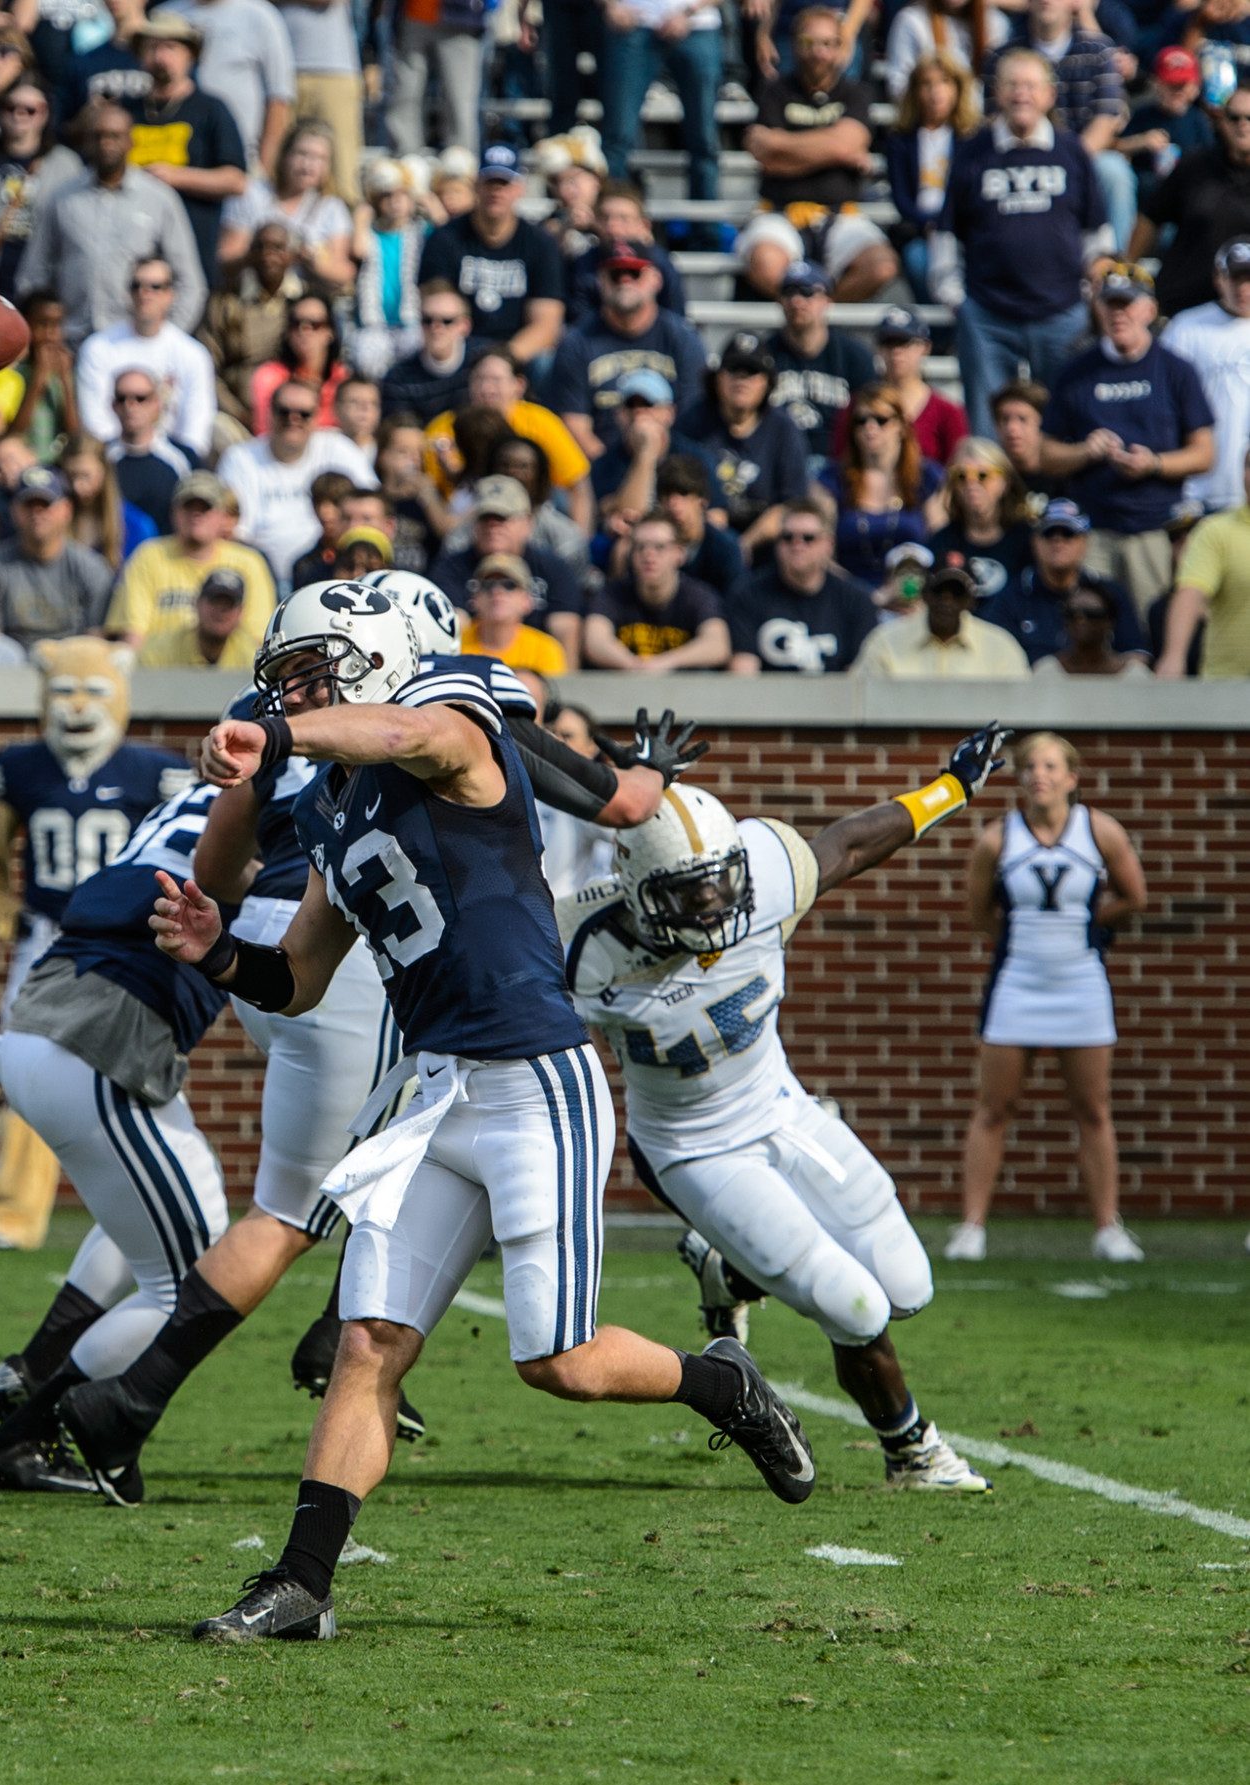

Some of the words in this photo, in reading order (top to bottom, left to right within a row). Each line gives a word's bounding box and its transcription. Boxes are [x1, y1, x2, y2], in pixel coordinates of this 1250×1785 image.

[327, 584, 377, 613] Y
[29, 806, 132, 893] 00
[1030, 864, 1071, 911] Y
[660, 983, 695, 1006] TECH
[622, 972, 784, 1080] 45
